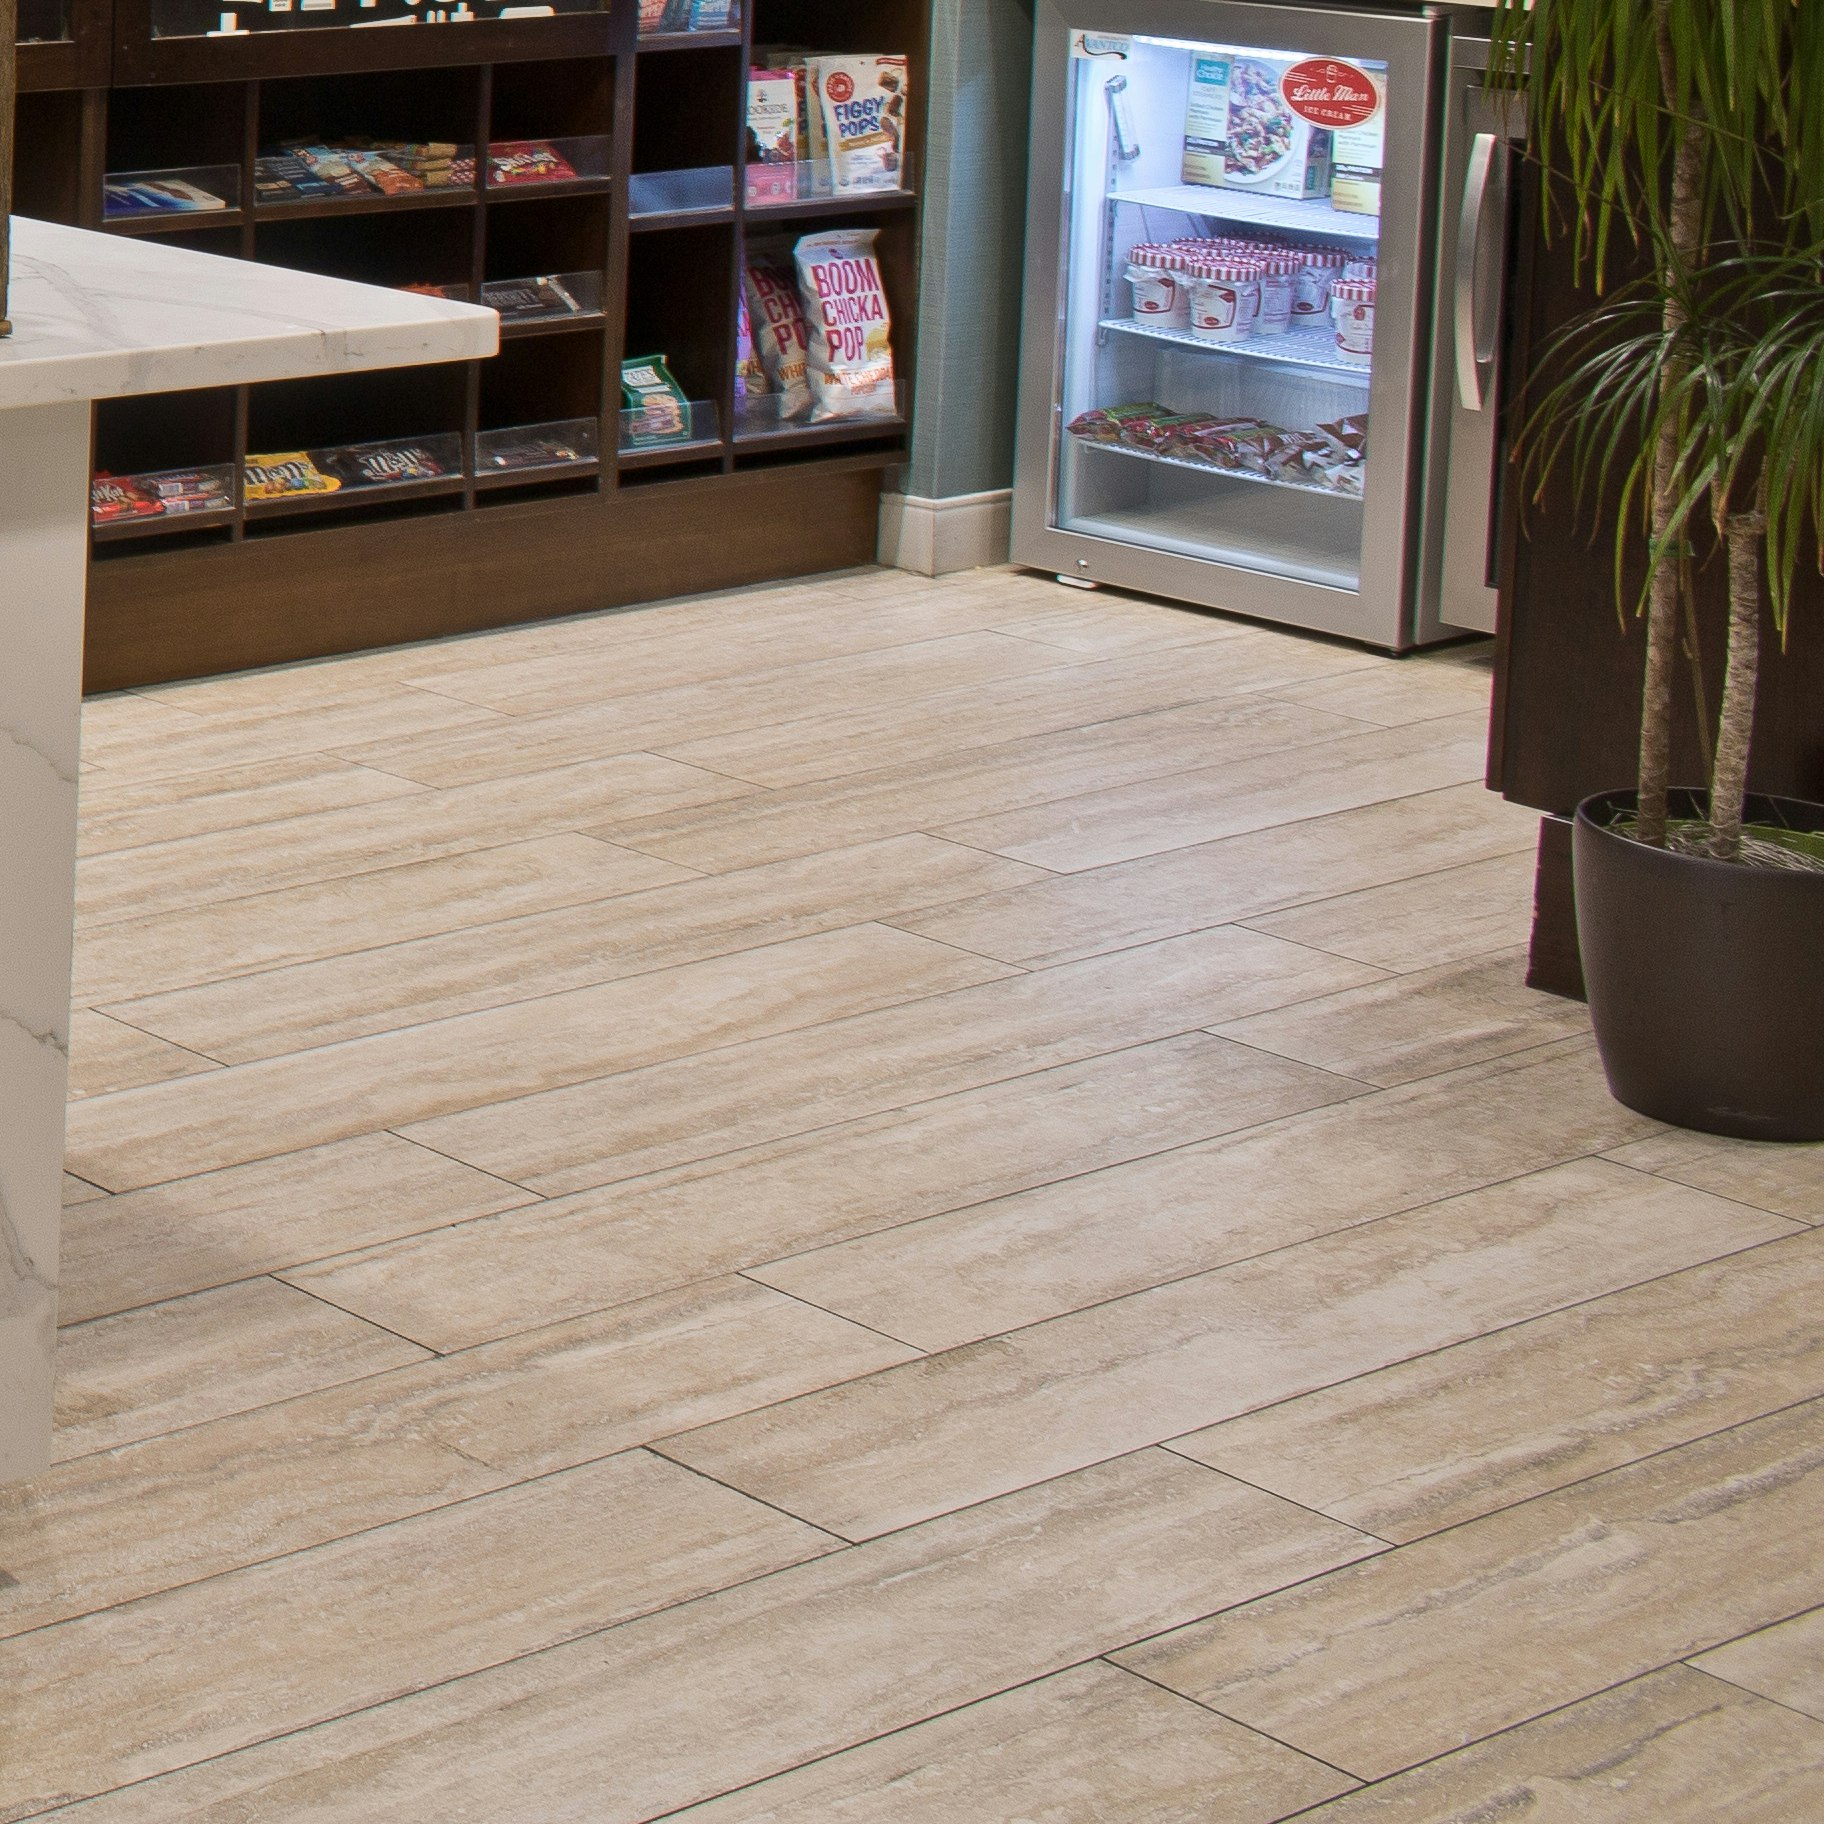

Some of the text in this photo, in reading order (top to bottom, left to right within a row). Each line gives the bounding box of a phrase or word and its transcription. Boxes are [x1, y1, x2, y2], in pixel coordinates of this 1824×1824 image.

[1291, 84, 1369, 102] Little Man
[833, 95, 885, 121] FIGGY
[1304, 105, 1352, 121] ICE CREAM
[839, 116, 881, 138] POPS
[811, 258, 880, 299] BOOM
[821, 294, 884, 327] CHICKA
[825, 326, 865, 363] POP
